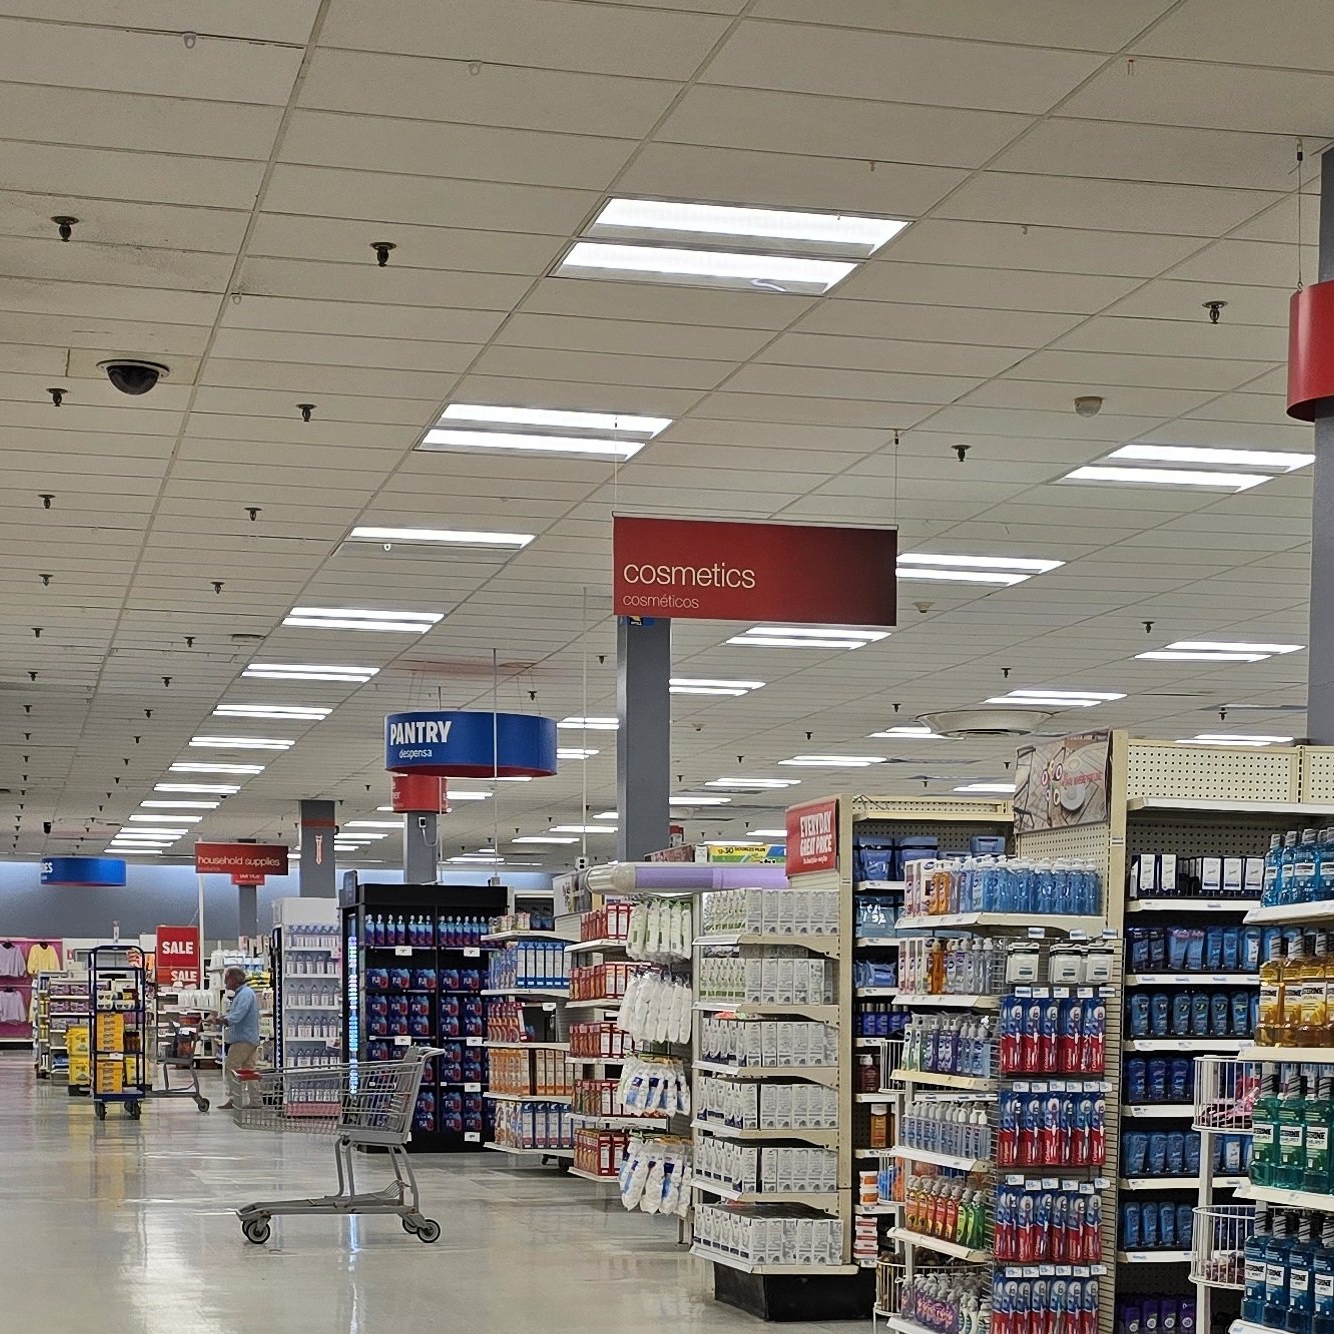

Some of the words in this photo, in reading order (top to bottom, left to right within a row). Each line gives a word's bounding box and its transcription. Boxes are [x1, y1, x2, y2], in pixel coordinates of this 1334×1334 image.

[622, 561, 756, 590] cosmetics
[622, 592, 700, 610] cosméticos
[389, 720, 453, 747] PANTRY
[398, 748, 434, 760] despensa
[799, 810, 832, 838] EVERYDAY
[800, 836, 816, 857] GREAT
[815, 833, 833, 855] PRICE
[197, 854, 244, 867] household
[243, 856, 281, 868] supplies
[161, 940, 194, 955] SALE
[170, 970, 198, 983] SALE
